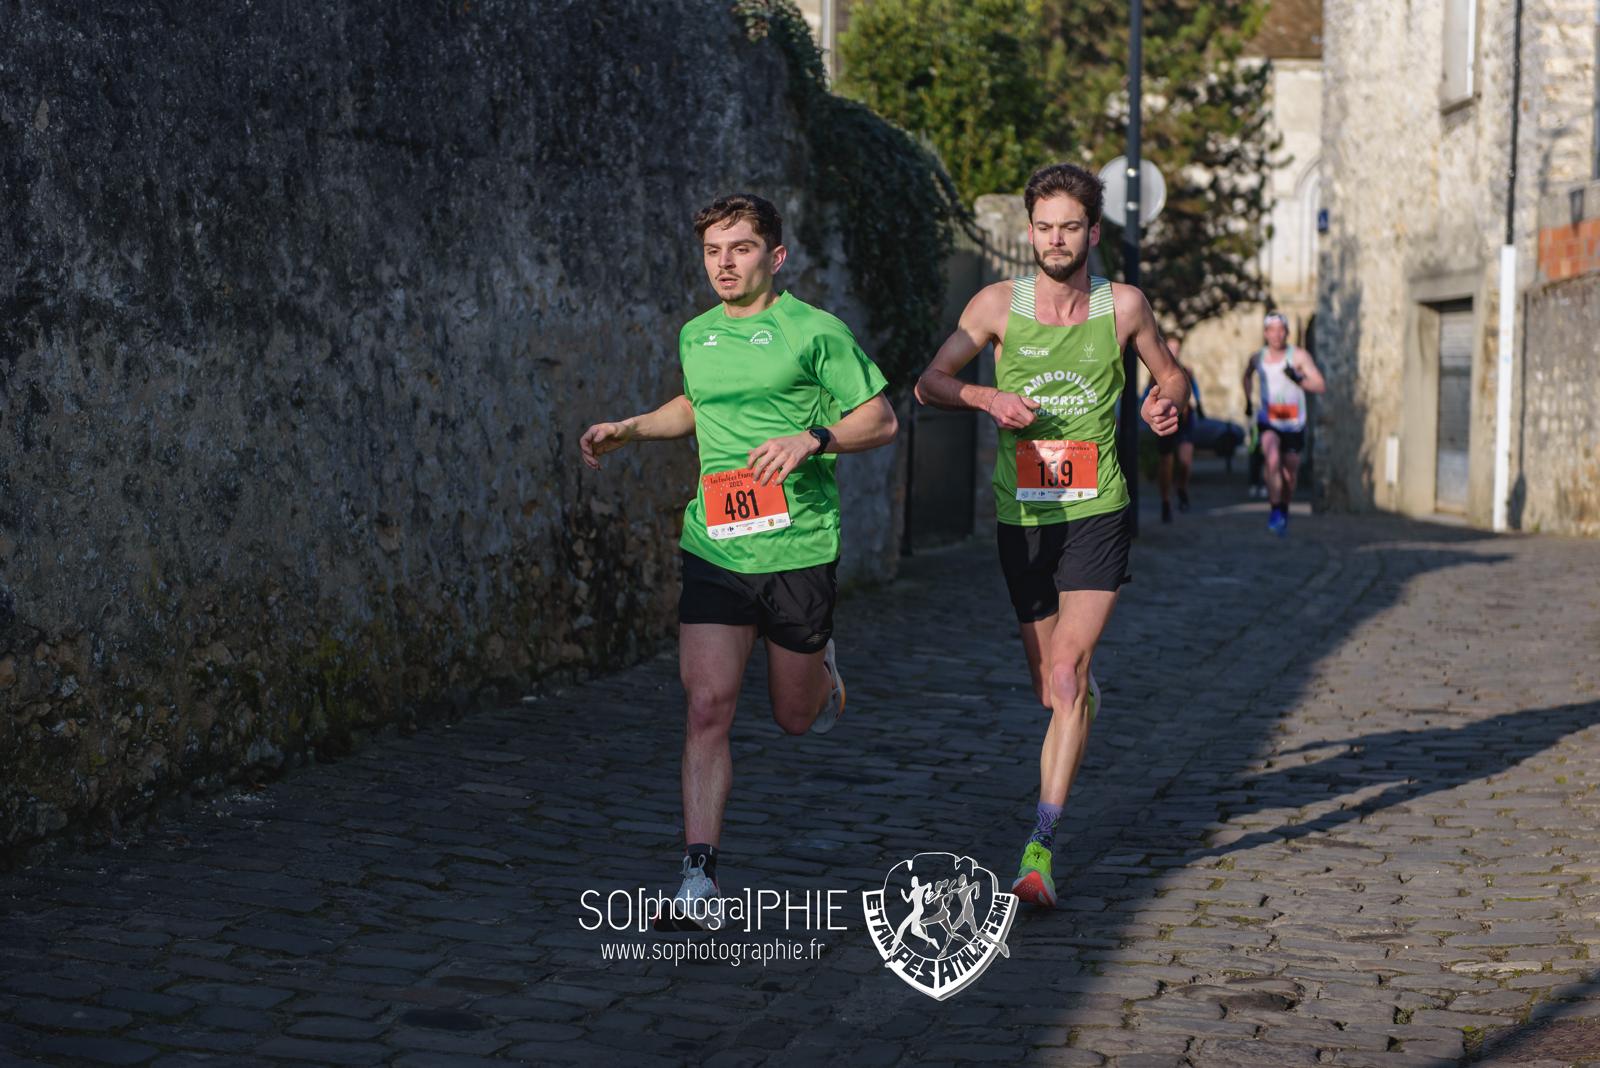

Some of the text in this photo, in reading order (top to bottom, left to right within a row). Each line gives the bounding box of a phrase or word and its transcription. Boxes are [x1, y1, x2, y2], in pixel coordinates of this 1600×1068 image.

[1022, 370, 1099, 404] AMBOUILLET
[1032, 395, 1084, 406] SPORTS
[725, 488, 759, 520] 481
